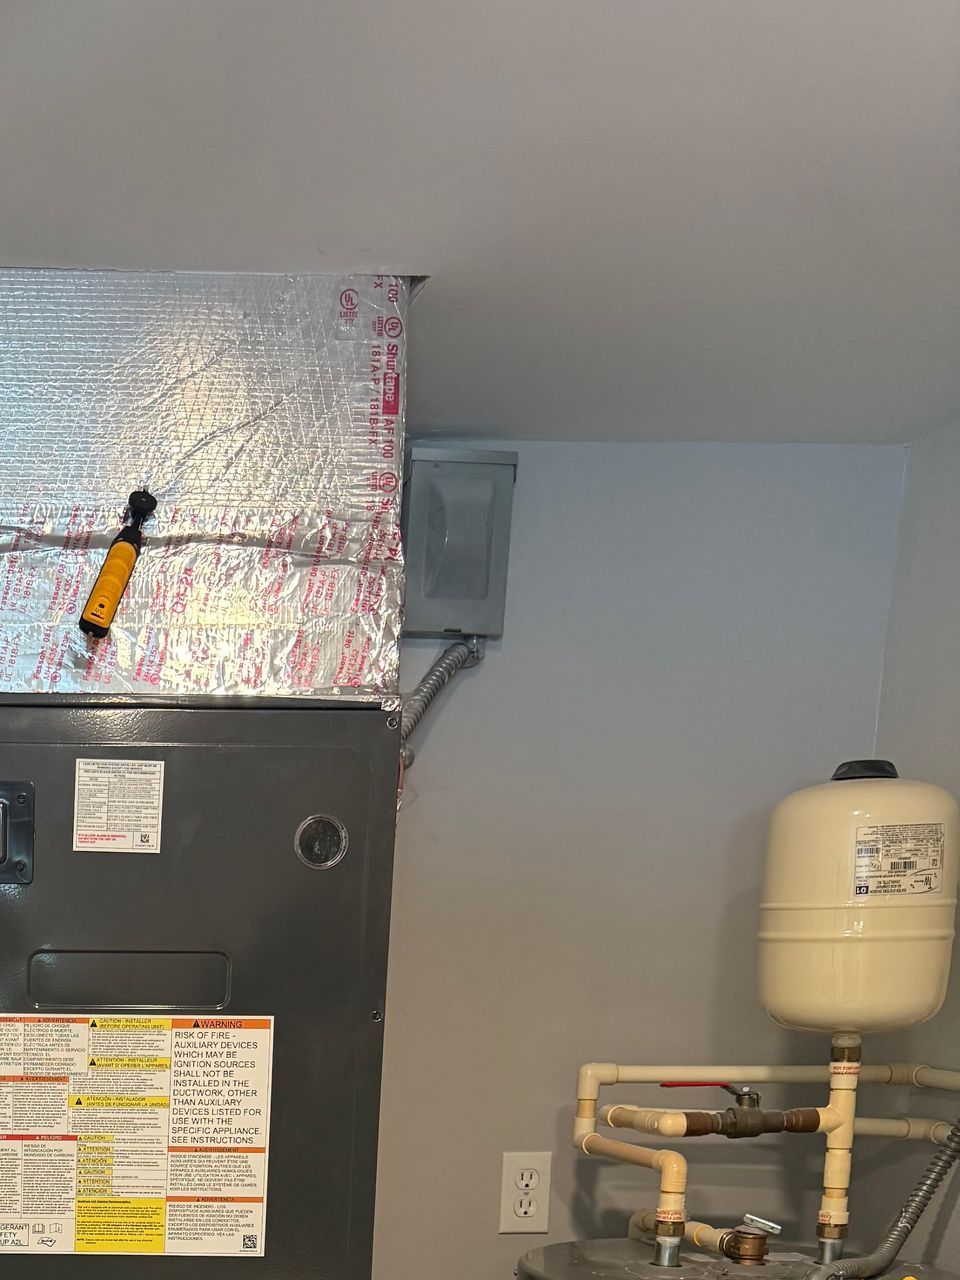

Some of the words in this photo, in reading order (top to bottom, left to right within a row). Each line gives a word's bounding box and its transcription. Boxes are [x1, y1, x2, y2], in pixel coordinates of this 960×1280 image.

[370, 343, 381, 386] 181A-P
[385, 343, 399, 402] Shurtape
[368, 398, 380, 446] 181B-FX
[383, 419, 395, 438] AF
[382, 444, 394, 459] 100
[8, 631, 23, 668] 181B-FX
[201, 1021, 242, 1029] WARNING
[226, 1051, 237, 1059] BE
[173, 1070, 200, 1078] SHALL
[202, 1070, 220, 1078] NOT
[223, 1070, 235, 1078] BE
[172, 1089, 226, 1098] DUCTWORK,
[227, 1089, 258, 1097] OTHER
[211, 1108, 241, 1116] LISTED
[243, 1108, 261, 1116] FOR
[171, 1127, 211, 1135] SPECIFIC
[212, 1127, 262, 1135] APPLIANCE.
[171, 1136, 188, 1144] SEE
